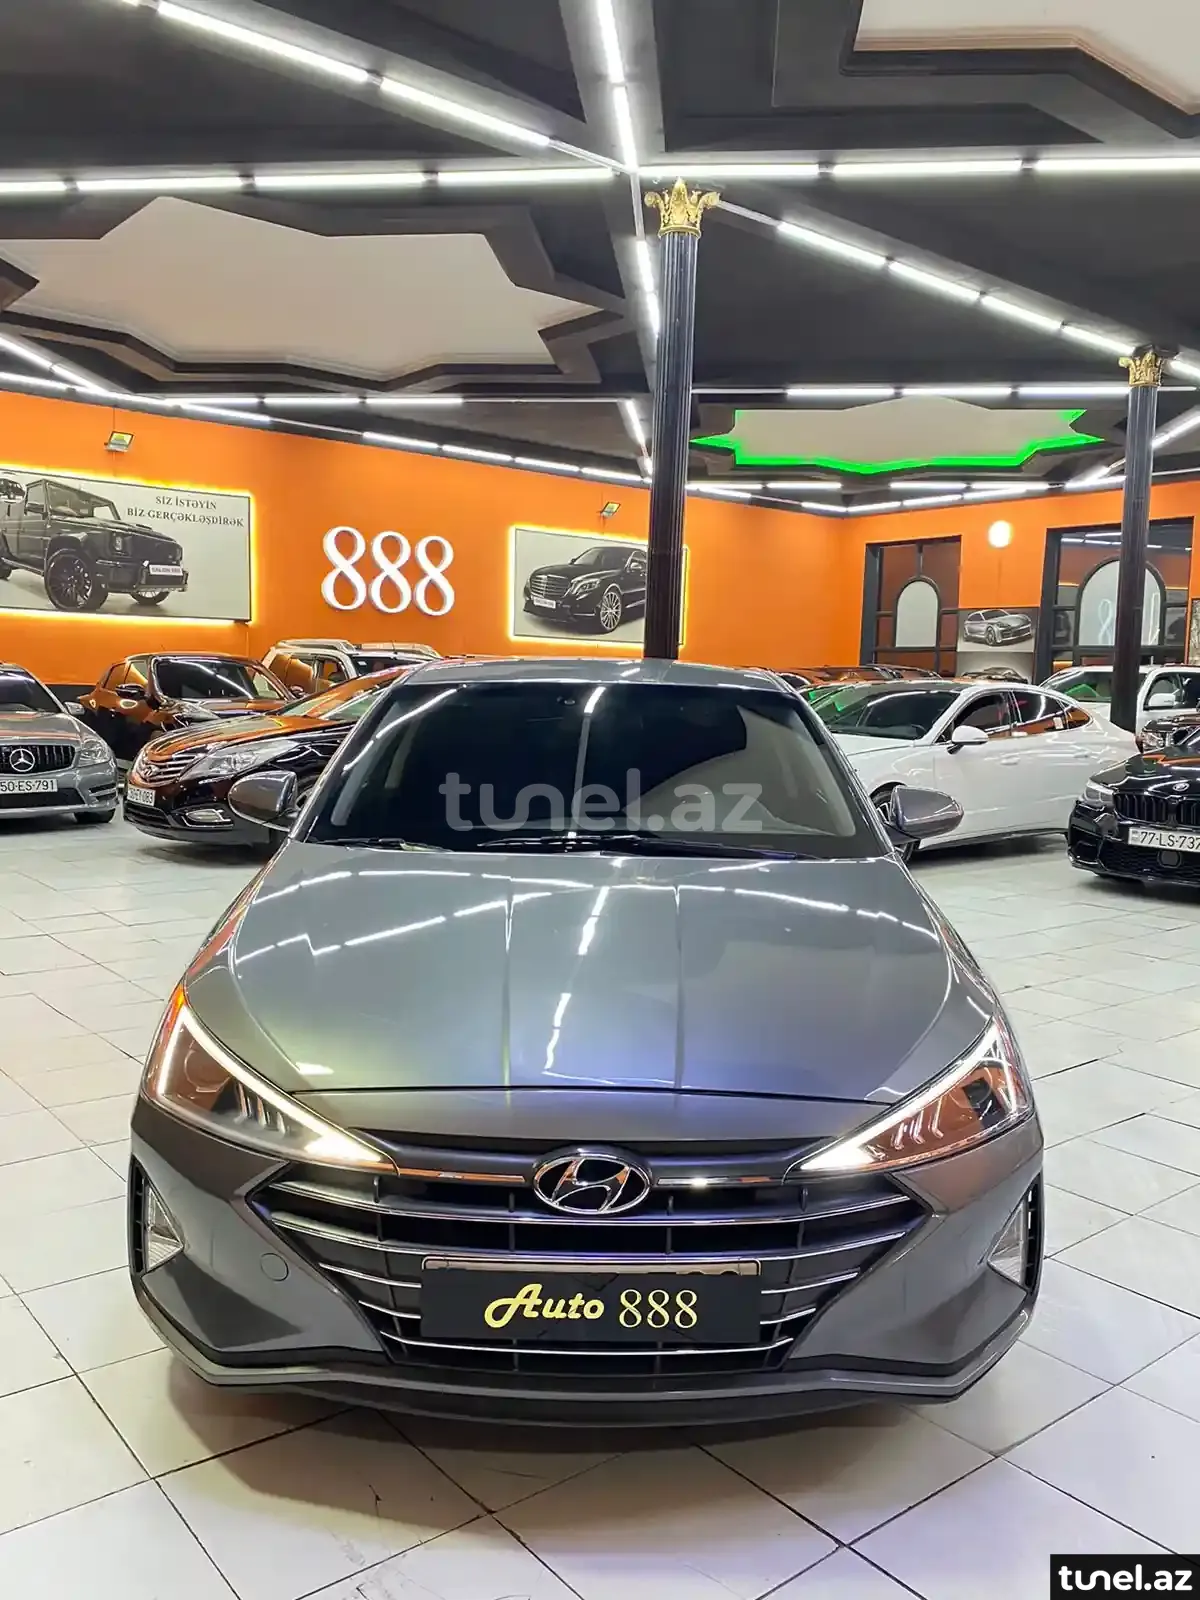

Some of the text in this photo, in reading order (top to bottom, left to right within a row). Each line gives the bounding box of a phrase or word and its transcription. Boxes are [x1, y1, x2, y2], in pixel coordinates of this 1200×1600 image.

[321, 526, 455, 616] 888
[484, 1283, 698, 1329] Auto 888
